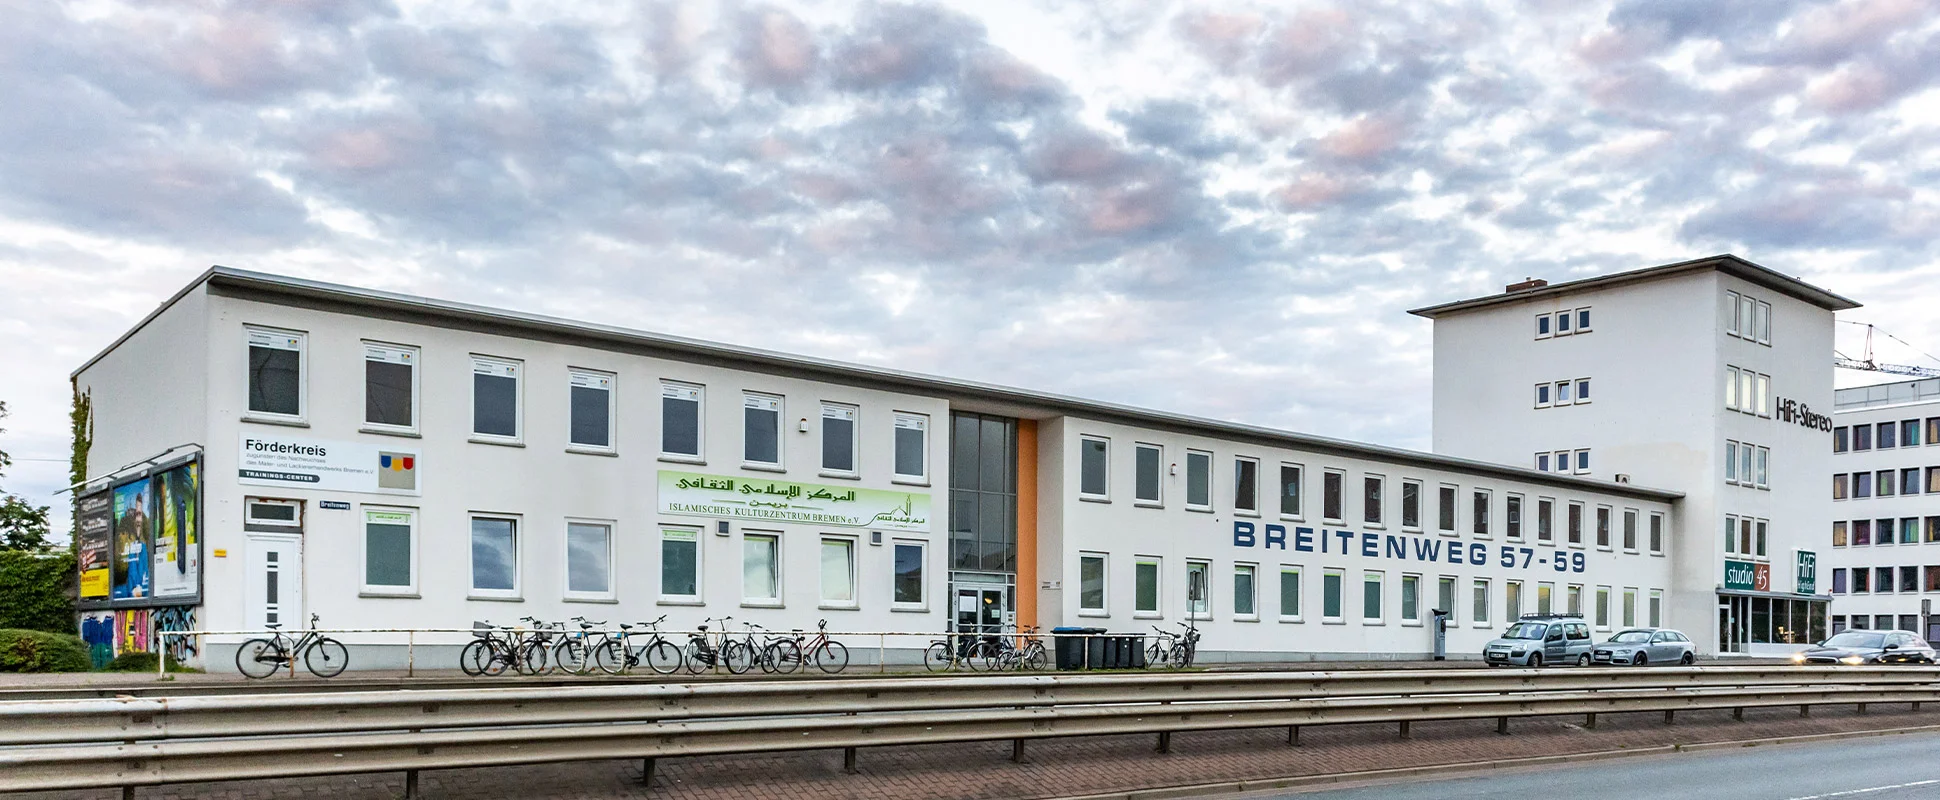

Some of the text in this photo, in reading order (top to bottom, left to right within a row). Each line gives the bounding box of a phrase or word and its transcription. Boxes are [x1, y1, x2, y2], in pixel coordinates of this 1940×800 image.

[1776, 396, 1833, 433] HiFi-Stereo
[245, 438, 327, 457] Förderkreis
[245, 471, 314, 481] TRAININGS-CENTER
[675, 476, 855, 502] المركز الإسلامي الثقافي
[669, 502, 861, 525] ISLAMISCHES KULTURZENTRUM BREMEN e.V.
[749, 499, 788, 509] بريمن
[1234, 521, 1487, 566] BREITENWEG
[1727, 564, 1768, 590] studio 45
[1797, 552, 1815, 579] HiFi
